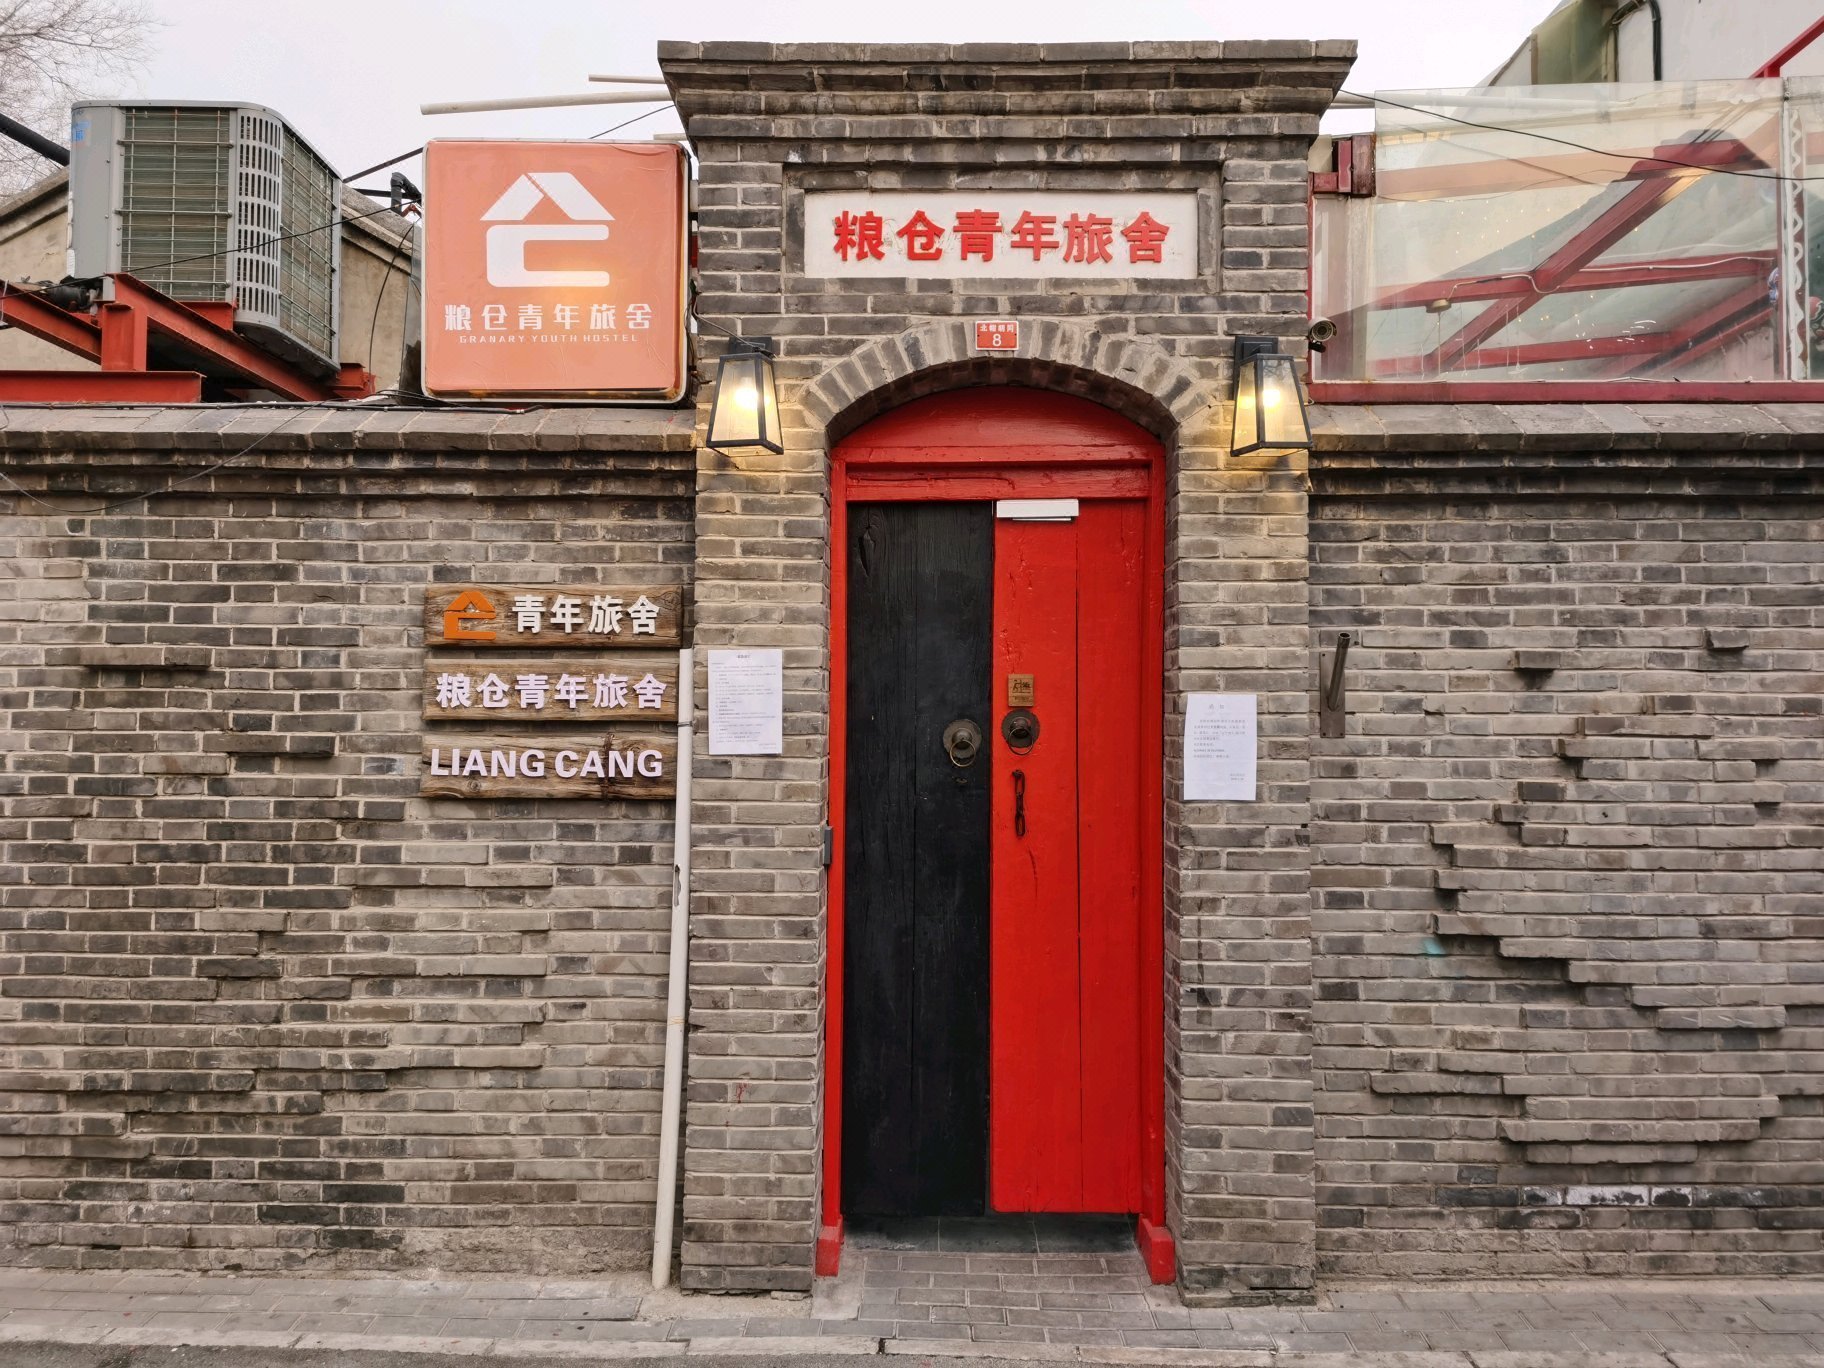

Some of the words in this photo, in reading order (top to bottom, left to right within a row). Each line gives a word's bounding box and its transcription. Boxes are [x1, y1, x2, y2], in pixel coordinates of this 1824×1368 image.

[834, 209, 1170, 264] 粮仓青年旅舍
[444, 303, 652, 331] 粮仓青年旅舍
[459, 335, 525, 344] GRANARY
[532, 335, 578, 343] YOUTH
[583, 334, 638, 343] HOSTEL
[992, 333, 1002, 347] 8
[512, 594, 660, 634] 青年旅舍
[436, 672, 667, 709] 粮仓青年旅舍
[430, 748, 546, 778] LIANG
[554, 749, 663, 779] CANG
